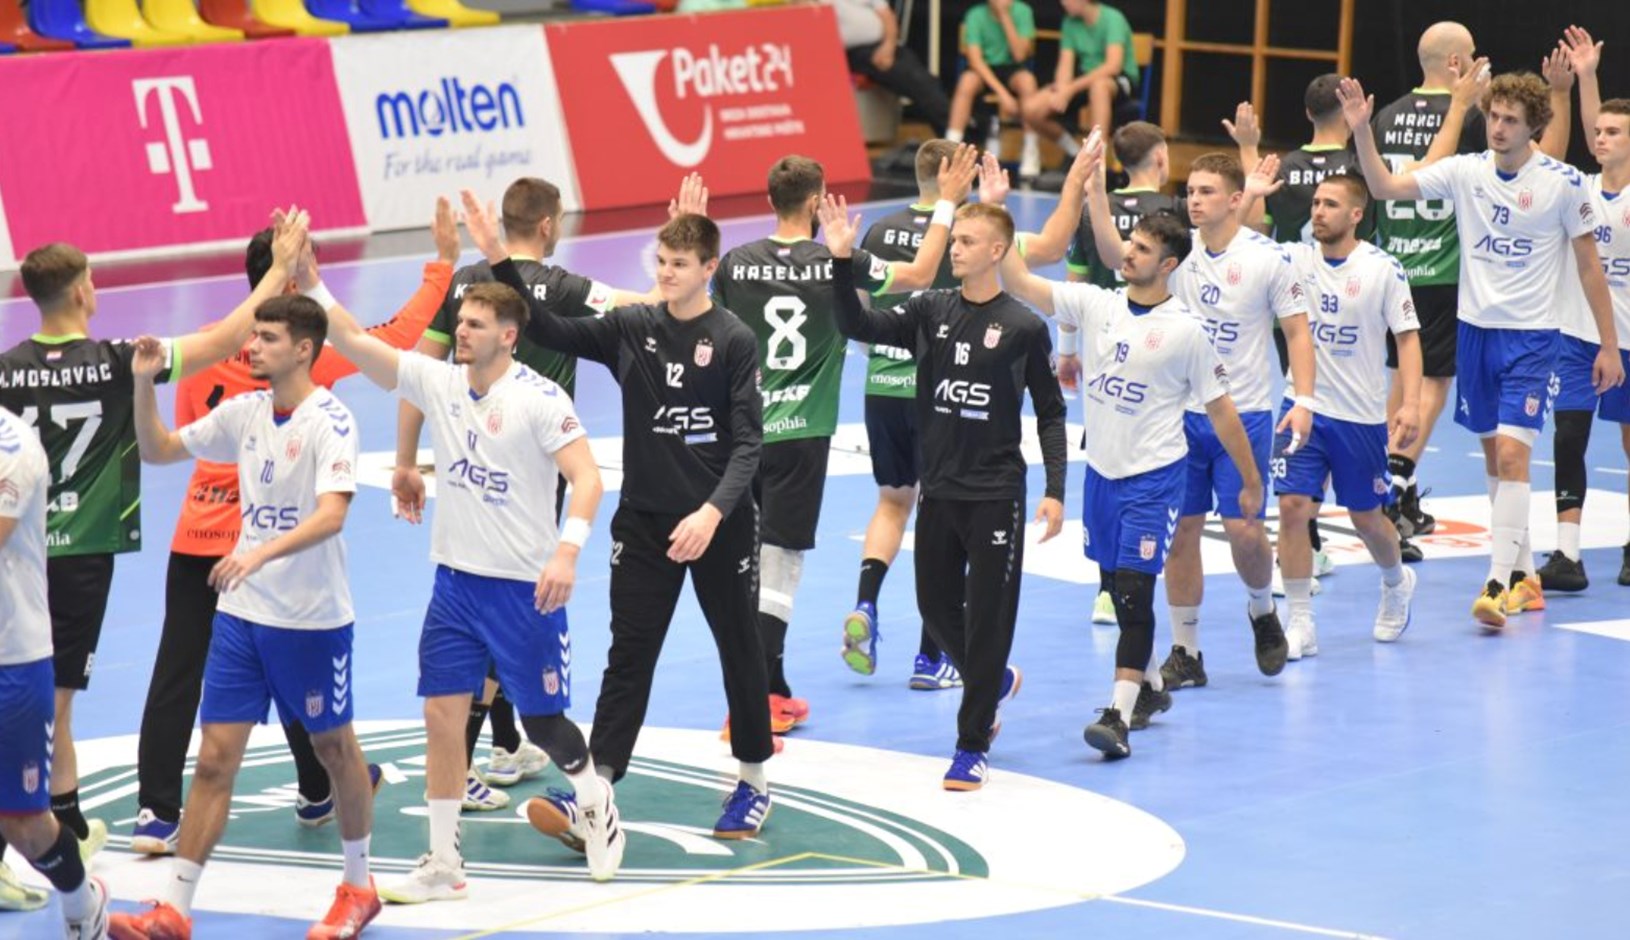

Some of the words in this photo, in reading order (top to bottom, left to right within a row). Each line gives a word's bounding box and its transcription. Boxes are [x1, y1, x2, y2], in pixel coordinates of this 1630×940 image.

[376, 76, 525, 139] molten
[1492, 204, 1511, 226] 73
[1474, 234, 1534, 257] AGS
[1201, 284, 1220, 305] 20
[1321, 293, 1338, 314] 33
[764, 296, 807, 370] 8
[954, 342, 971, 366] 16
[1114, 341, 1130, 363] 19
[665, 361, 685, 389] 12
[935, 378, 992, 406] AGS
[1088, 373, 1149, 404] AGS
[449, 457, 509, 494] AGS
